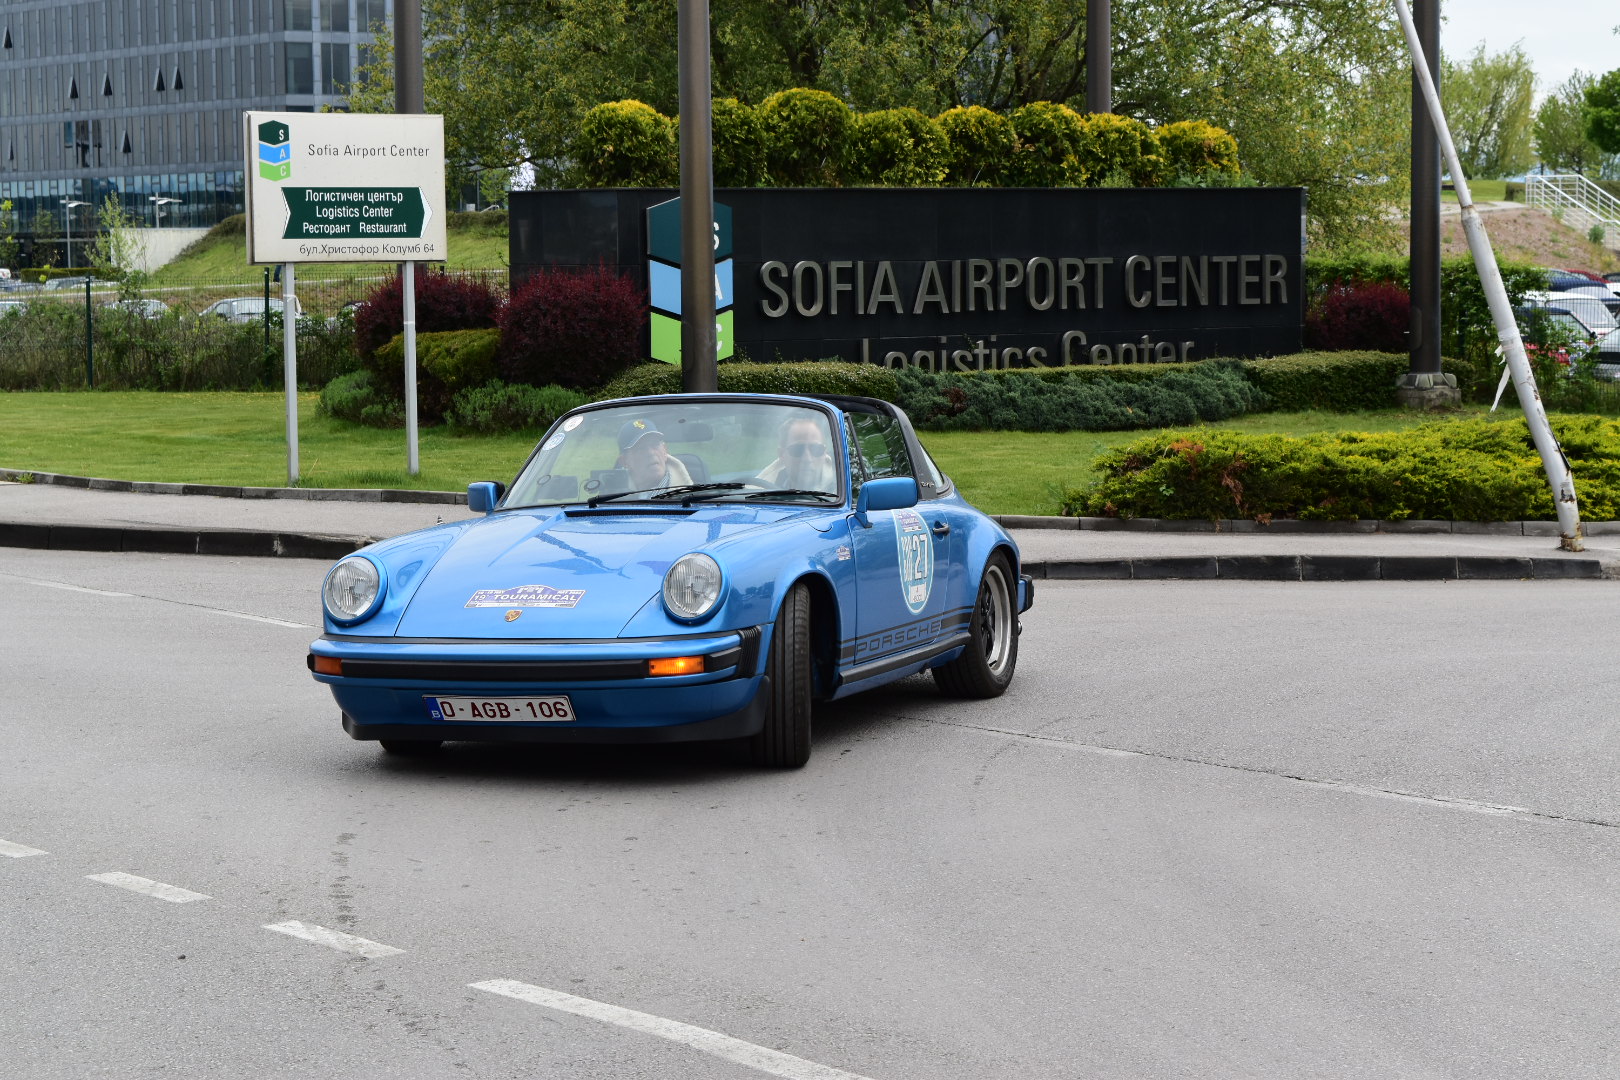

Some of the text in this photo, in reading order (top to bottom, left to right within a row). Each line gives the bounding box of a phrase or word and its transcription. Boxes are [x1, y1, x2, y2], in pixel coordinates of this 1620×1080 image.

[308, 143, 430, 159] Sofia Airport Center
[305, 190, 403, 204] Логистичен център
[316, 205, 394, 220] Logistics Center
[303, 222, 407, 235] Ресторант Restaurant
[382, 243, 421, 255] Колумб
[423, 243, 435, 253] 64
[760, 260, 904, 318] SOFIA
[912, 256, 1114, 315] AIRPORT
[1124, 254, 1288, 310] CENTER
[912, 533, 928, 581] 27
[855, 620, 941, 656] PORSCHE
